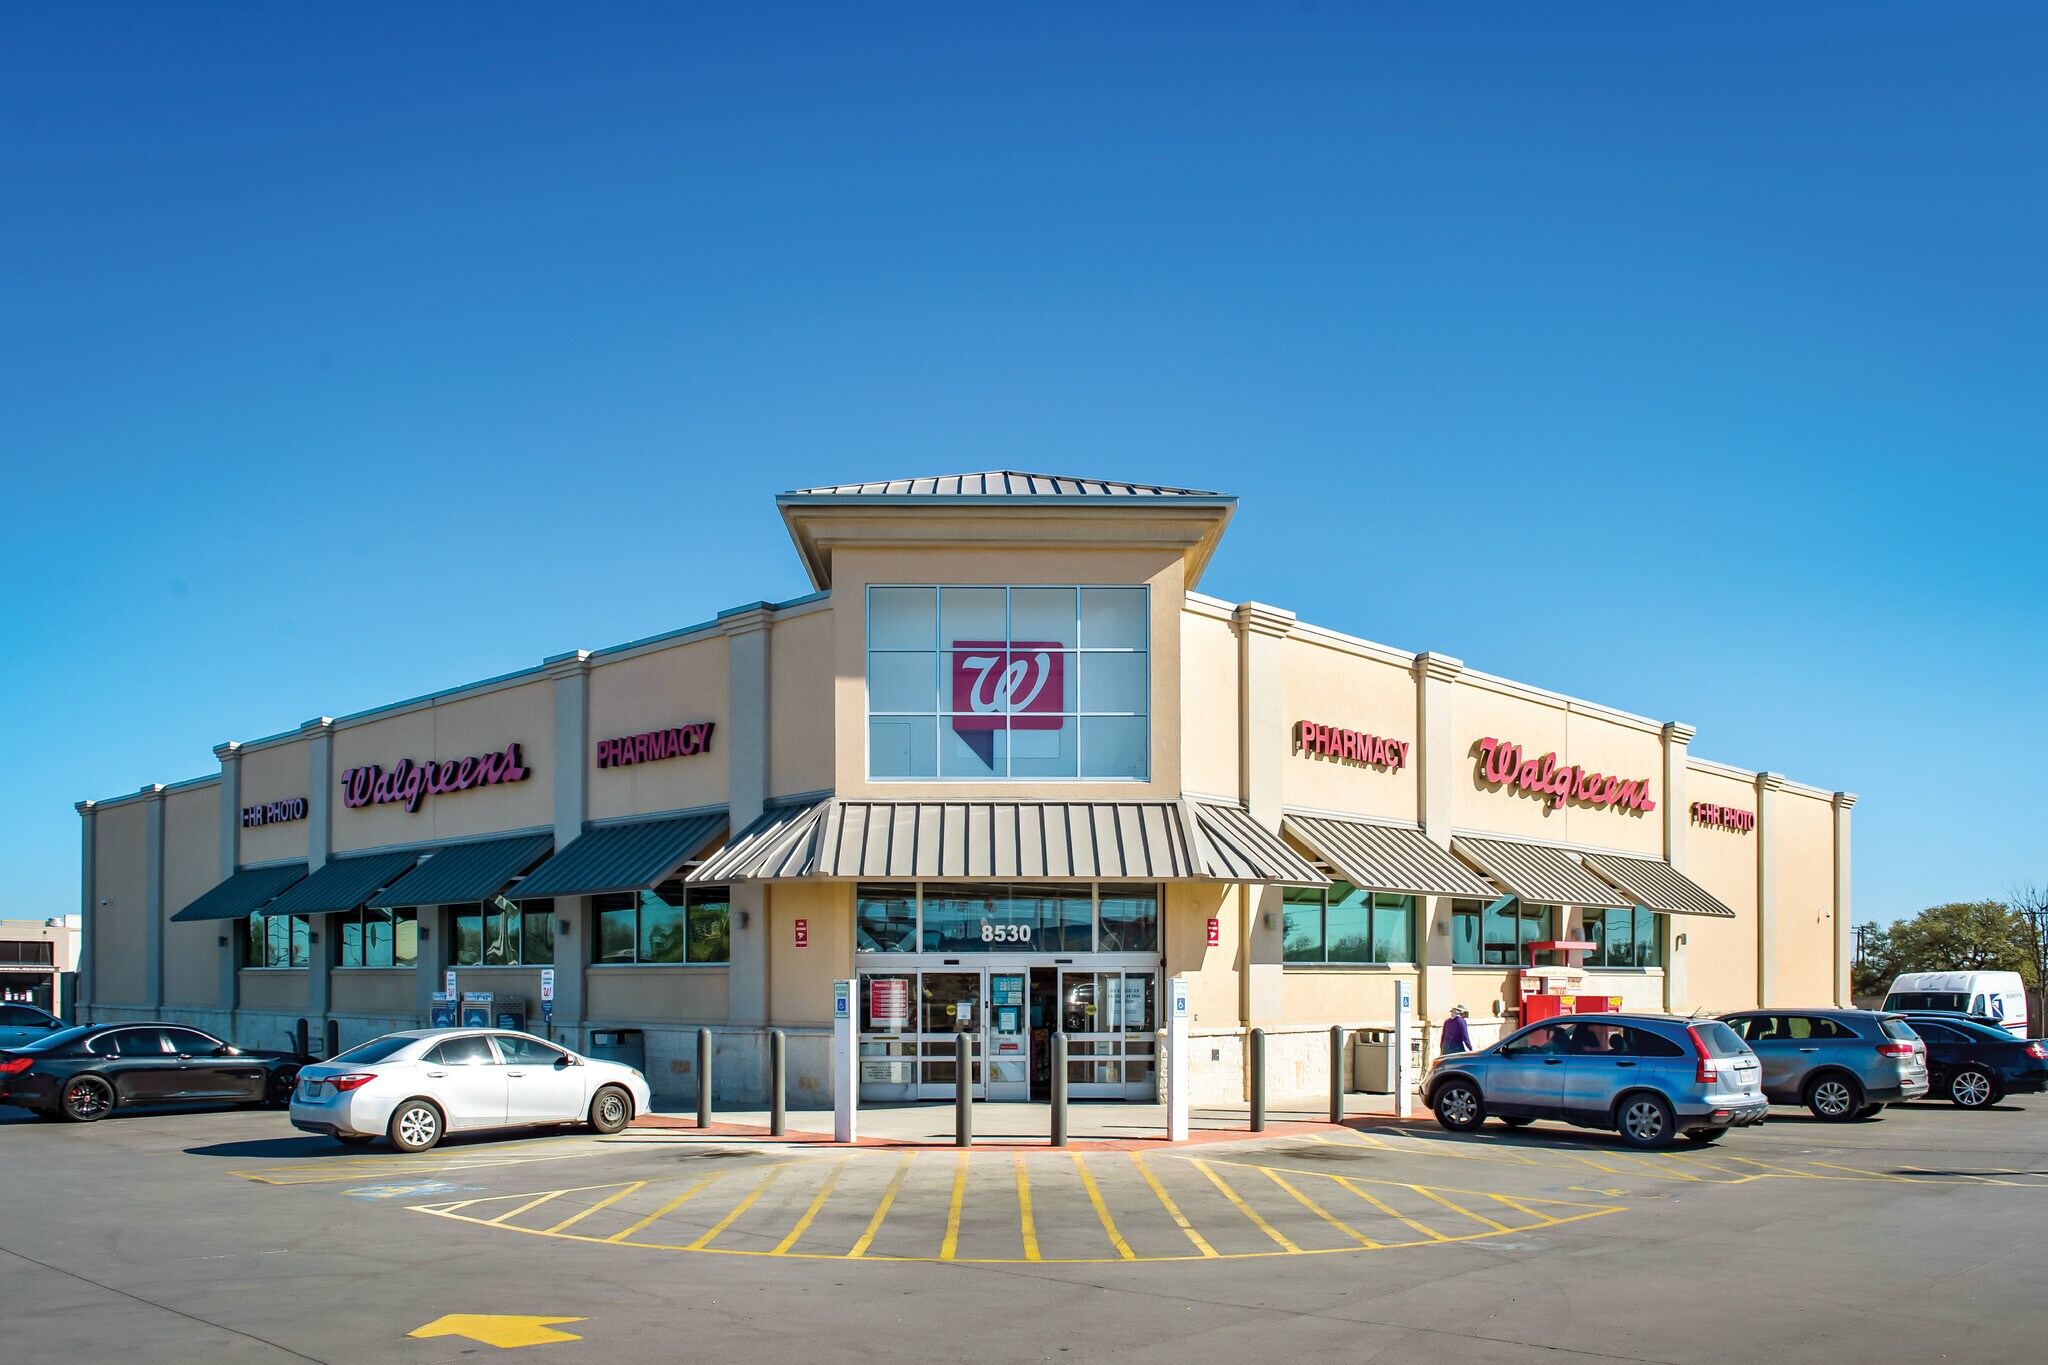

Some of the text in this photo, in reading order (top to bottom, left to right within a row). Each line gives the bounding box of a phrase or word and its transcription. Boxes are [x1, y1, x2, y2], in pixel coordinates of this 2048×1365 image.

[597, 721, 715, 769] PHARMACY
[1301, 719, 1410, 769] PHARMACY
[341, 742, 530, 814] Walgreens
[1479, 736, 1657, 811] Walgreens
[240, 796, 308, 828] 1-HR PHOTO
[1695, 801, 1755, 832] 1-HR PHOTO
[981, 924, 1032, 942] 8530
